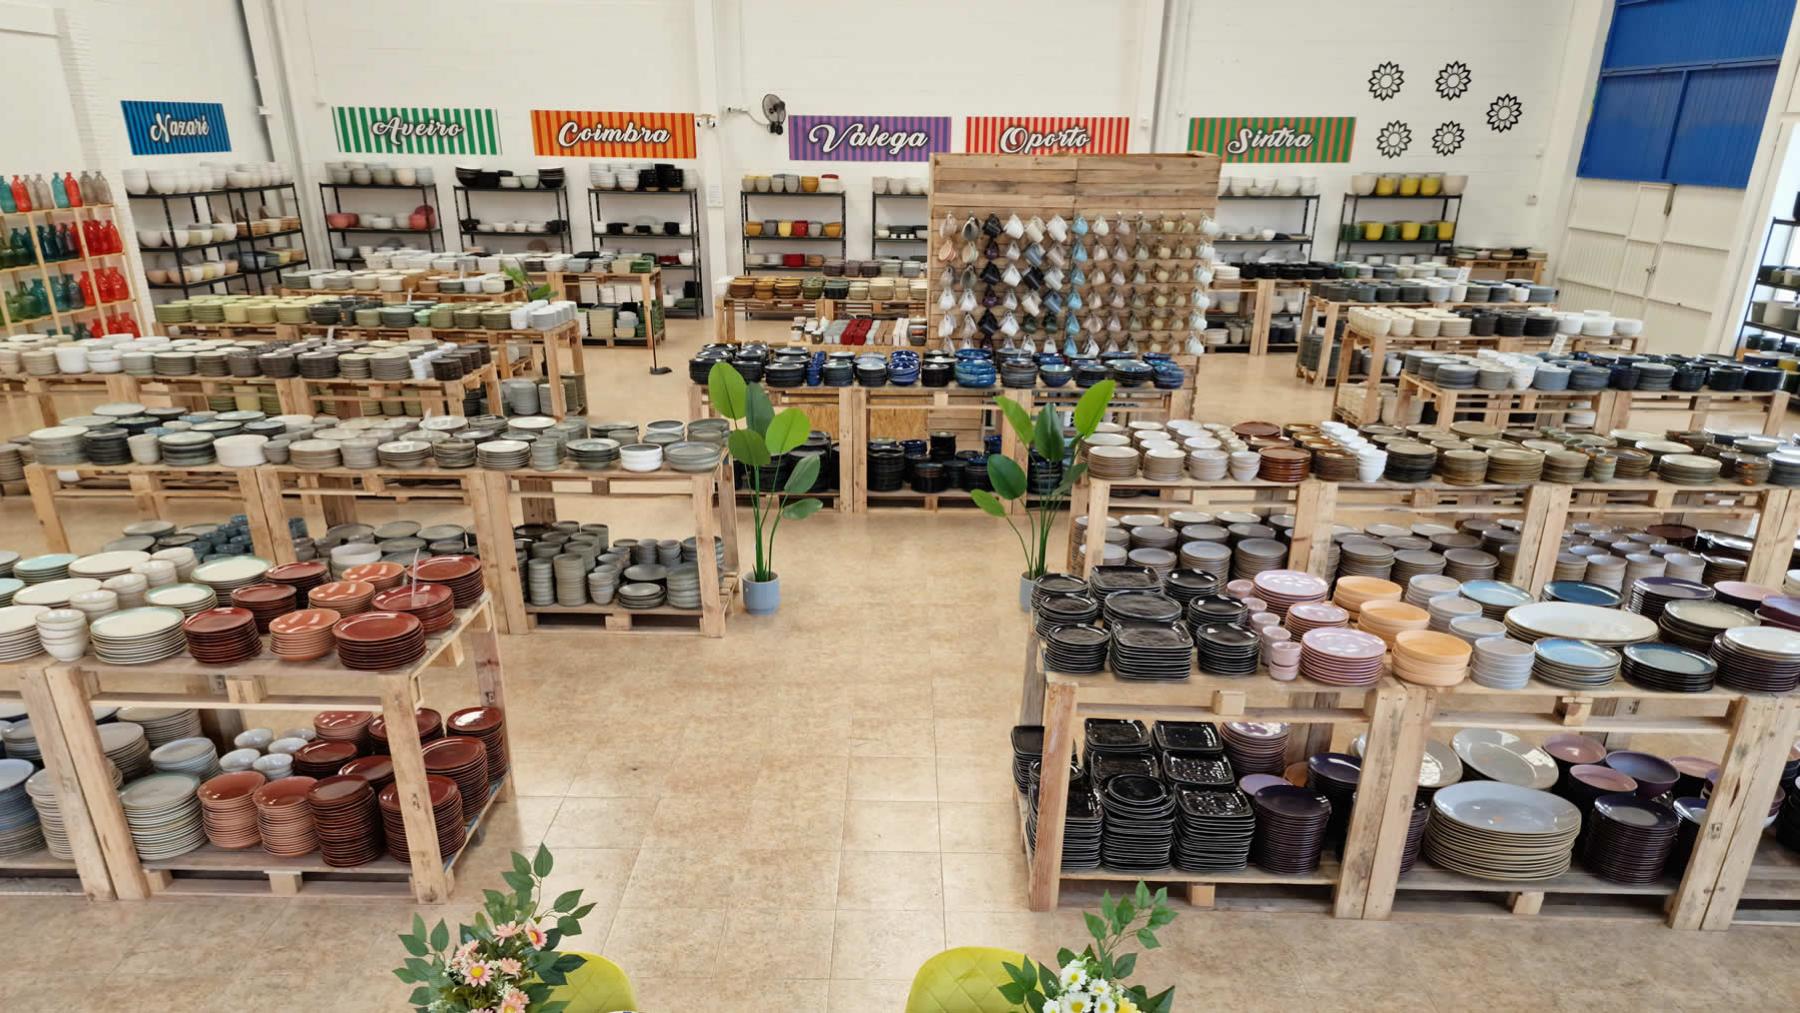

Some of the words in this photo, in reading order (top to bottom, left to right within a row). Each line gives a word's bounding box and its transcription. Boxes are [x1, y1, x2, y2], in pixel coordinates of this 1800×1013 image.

[371, 116, 465, 146] Aveiro
[558, 121, 671, 148] Coimbra
[1000, 126, 1091, 154] Oporto
[1226, 126, 1314, 154] Sintra
